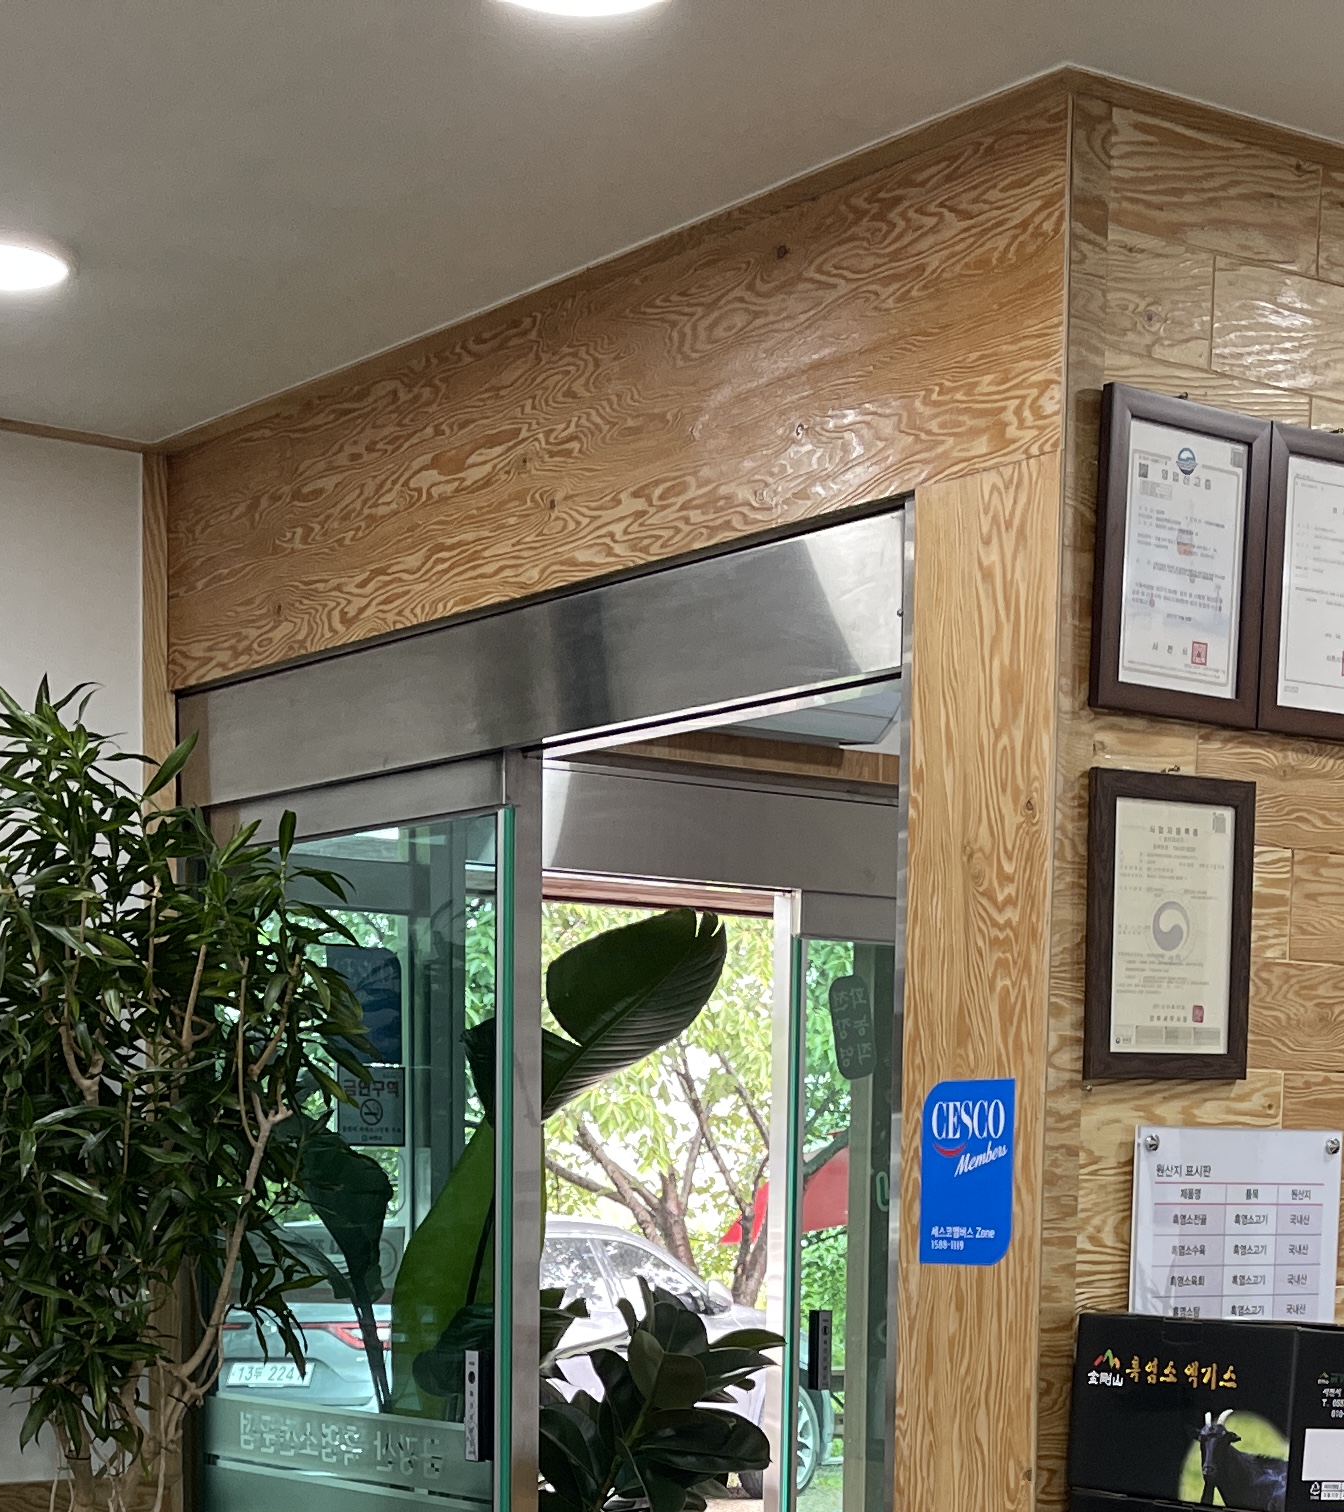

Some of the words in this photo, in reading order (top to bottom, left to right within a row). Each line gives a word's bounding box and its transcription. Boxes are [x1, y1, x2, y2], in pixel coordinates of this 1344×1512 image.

[343, 1078, 399, 1099] 금연구역
[931, 1098, 1006, 1141] CESCO
[953, 1140, 1009, 1178] Members
[1156, 1164, 1183, 1178] 원산지
[1185, 1164, 1212, 1179] 표시판
[1180, 1188, 1202, 1201] 제품명
[1245, 1188, 1259, 1200] 품목
[1291, 1189, 1312, 1201] 원산지
[1172, 1213, 1207, 1226] 흑염소전골
[1234, 1213, 1269, 1226] 흑염소고기
[1289, 1213, 1311, 1226] 국내산
[930, 1225, 975, 1239] 세스코멤버스
[975, 1226, 996, 1239] Zone
[1171, 1243, 1206, 1257] 흑염소수육
[1233, 1243, 1268, 1257] 흑염소고기
[1288, 1243, 1309, 1256] 국내산
[1169, 1274, 1205, 1288] 흑염소육회
[1231, 1273, 1266, 1287] 흑염소고기
[1287, 1273, 1308, 1286] 국내산
[1230, 1303, 1265, 1317] 흑염소고기
[1286, 1303, 1307, 1316] 국내산
[267, 1365, 309, 1383] 224
[1087, 1369, 1124, 1387] 金剛山
[1125, 1354, 1179, 1385] 흑염소
[1183, 1360, 1238, 1391] 엑기스
